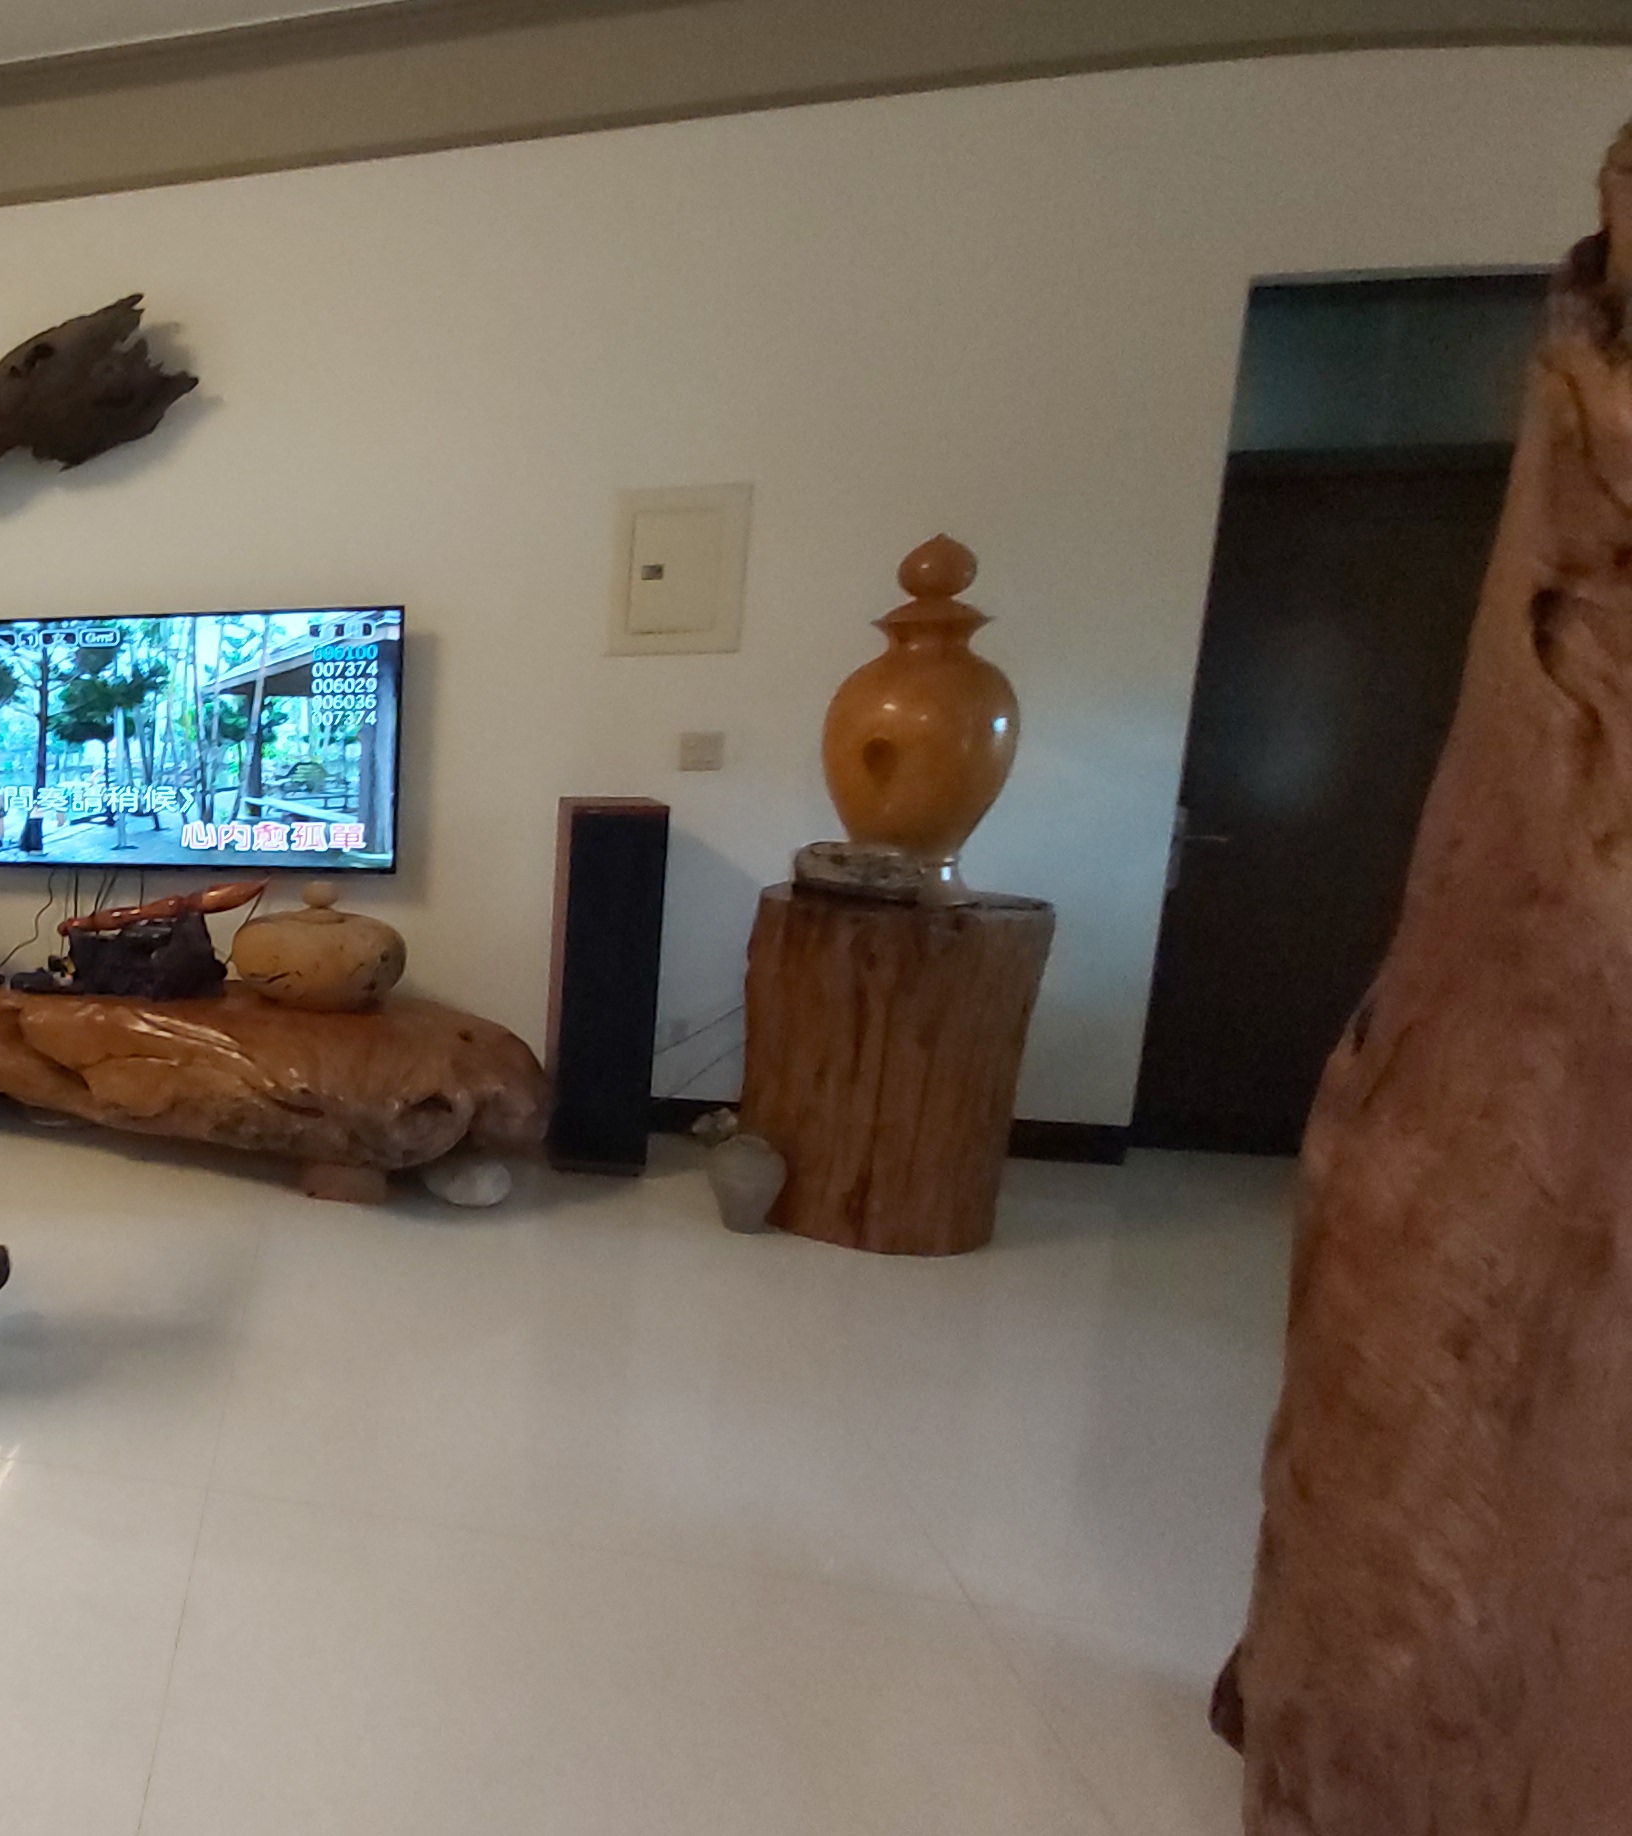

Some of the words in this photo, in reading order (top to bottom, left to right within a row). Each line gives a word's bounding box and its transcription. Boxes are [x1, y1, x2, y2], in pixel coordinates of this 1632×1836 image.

[312, 643, 379, 661] 006100
[311, 660, 378, 678] 007374
[311, 677, 378, 694] 006029
[311, 693, 377, 710] 006036
[311, 710, 377, 726] 007374
